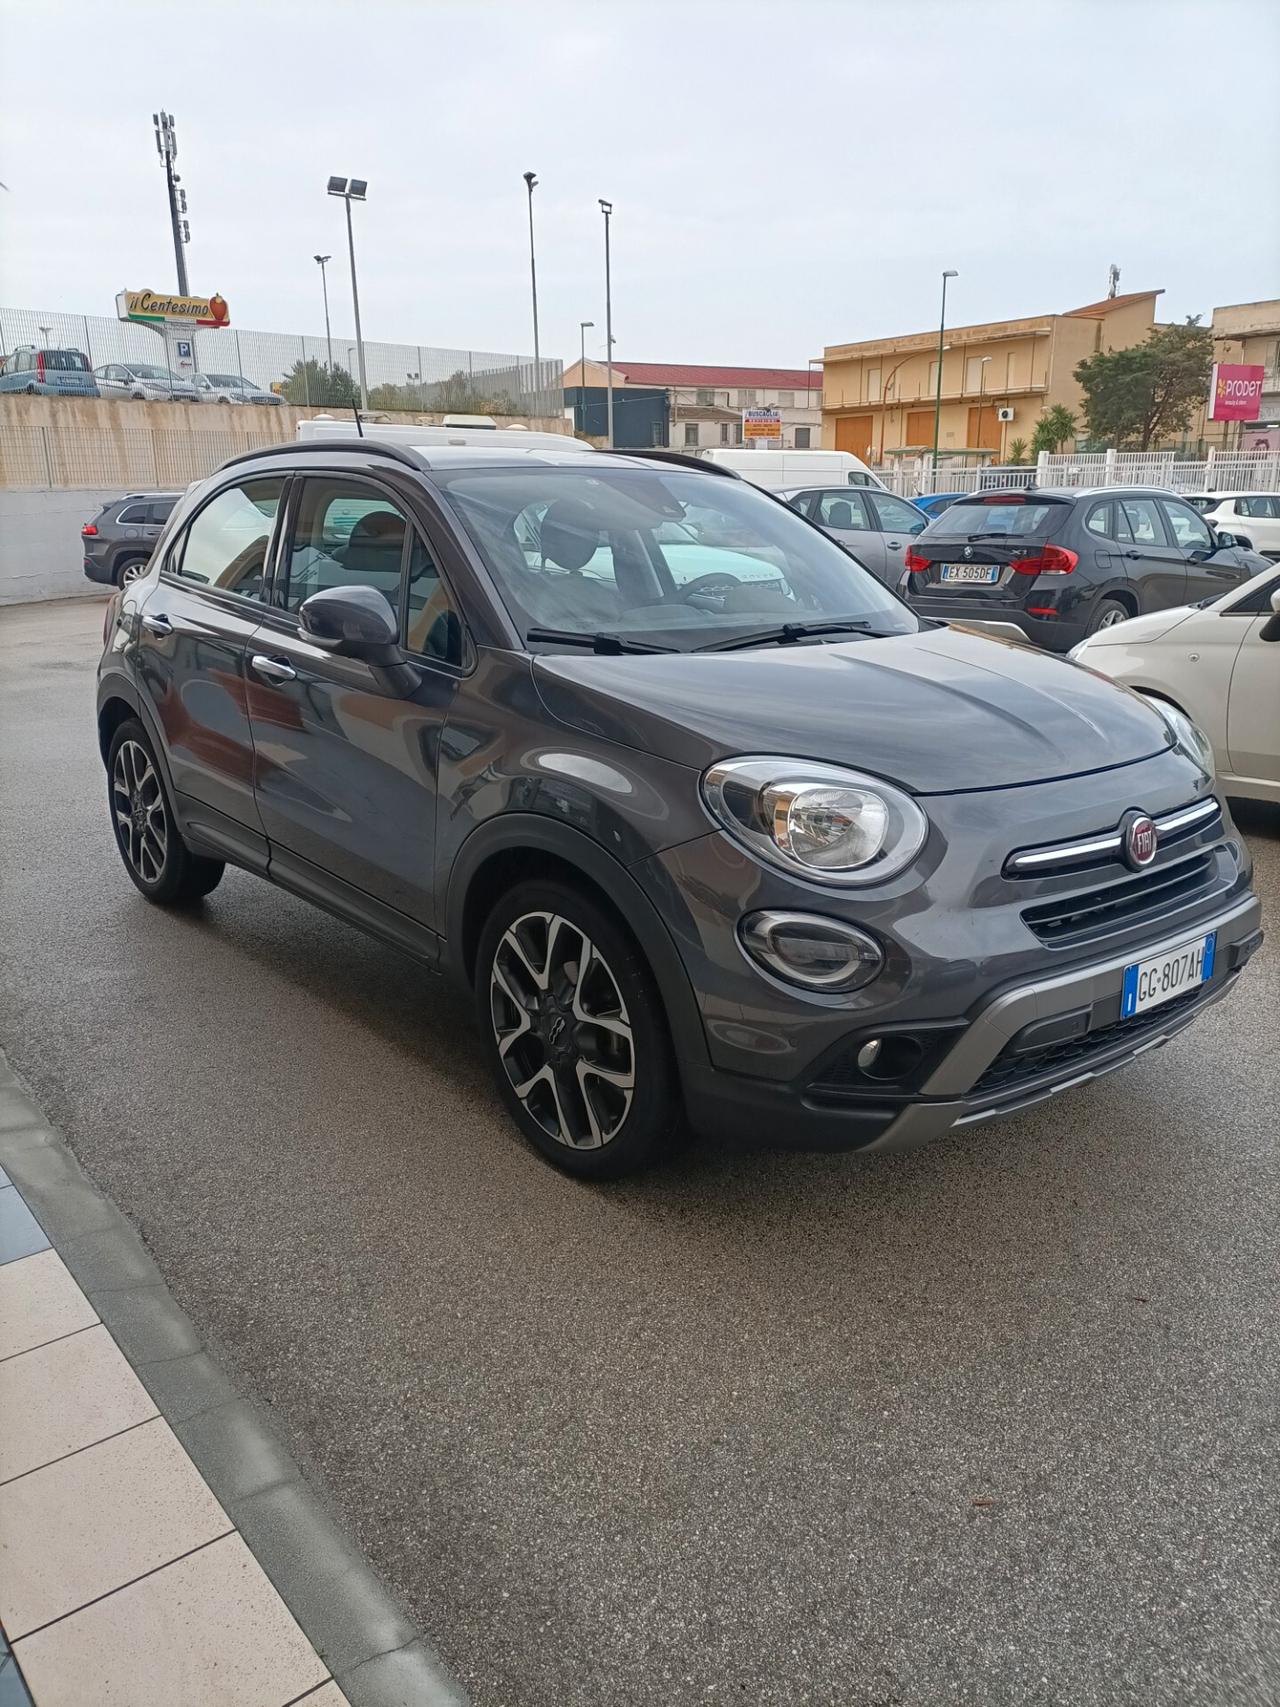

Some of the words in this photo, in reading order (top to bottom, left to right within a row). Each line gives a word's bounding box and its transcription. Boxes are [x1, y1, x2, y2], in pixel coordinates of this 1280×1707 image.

[129, 296, 139, 309] il
[140, 292, 209, 315] Centesimo
[949, 566, 960, 578] EX
[963, 567, 992, 579] 505DF
[1137, 830, 1152, 854] FIAT
